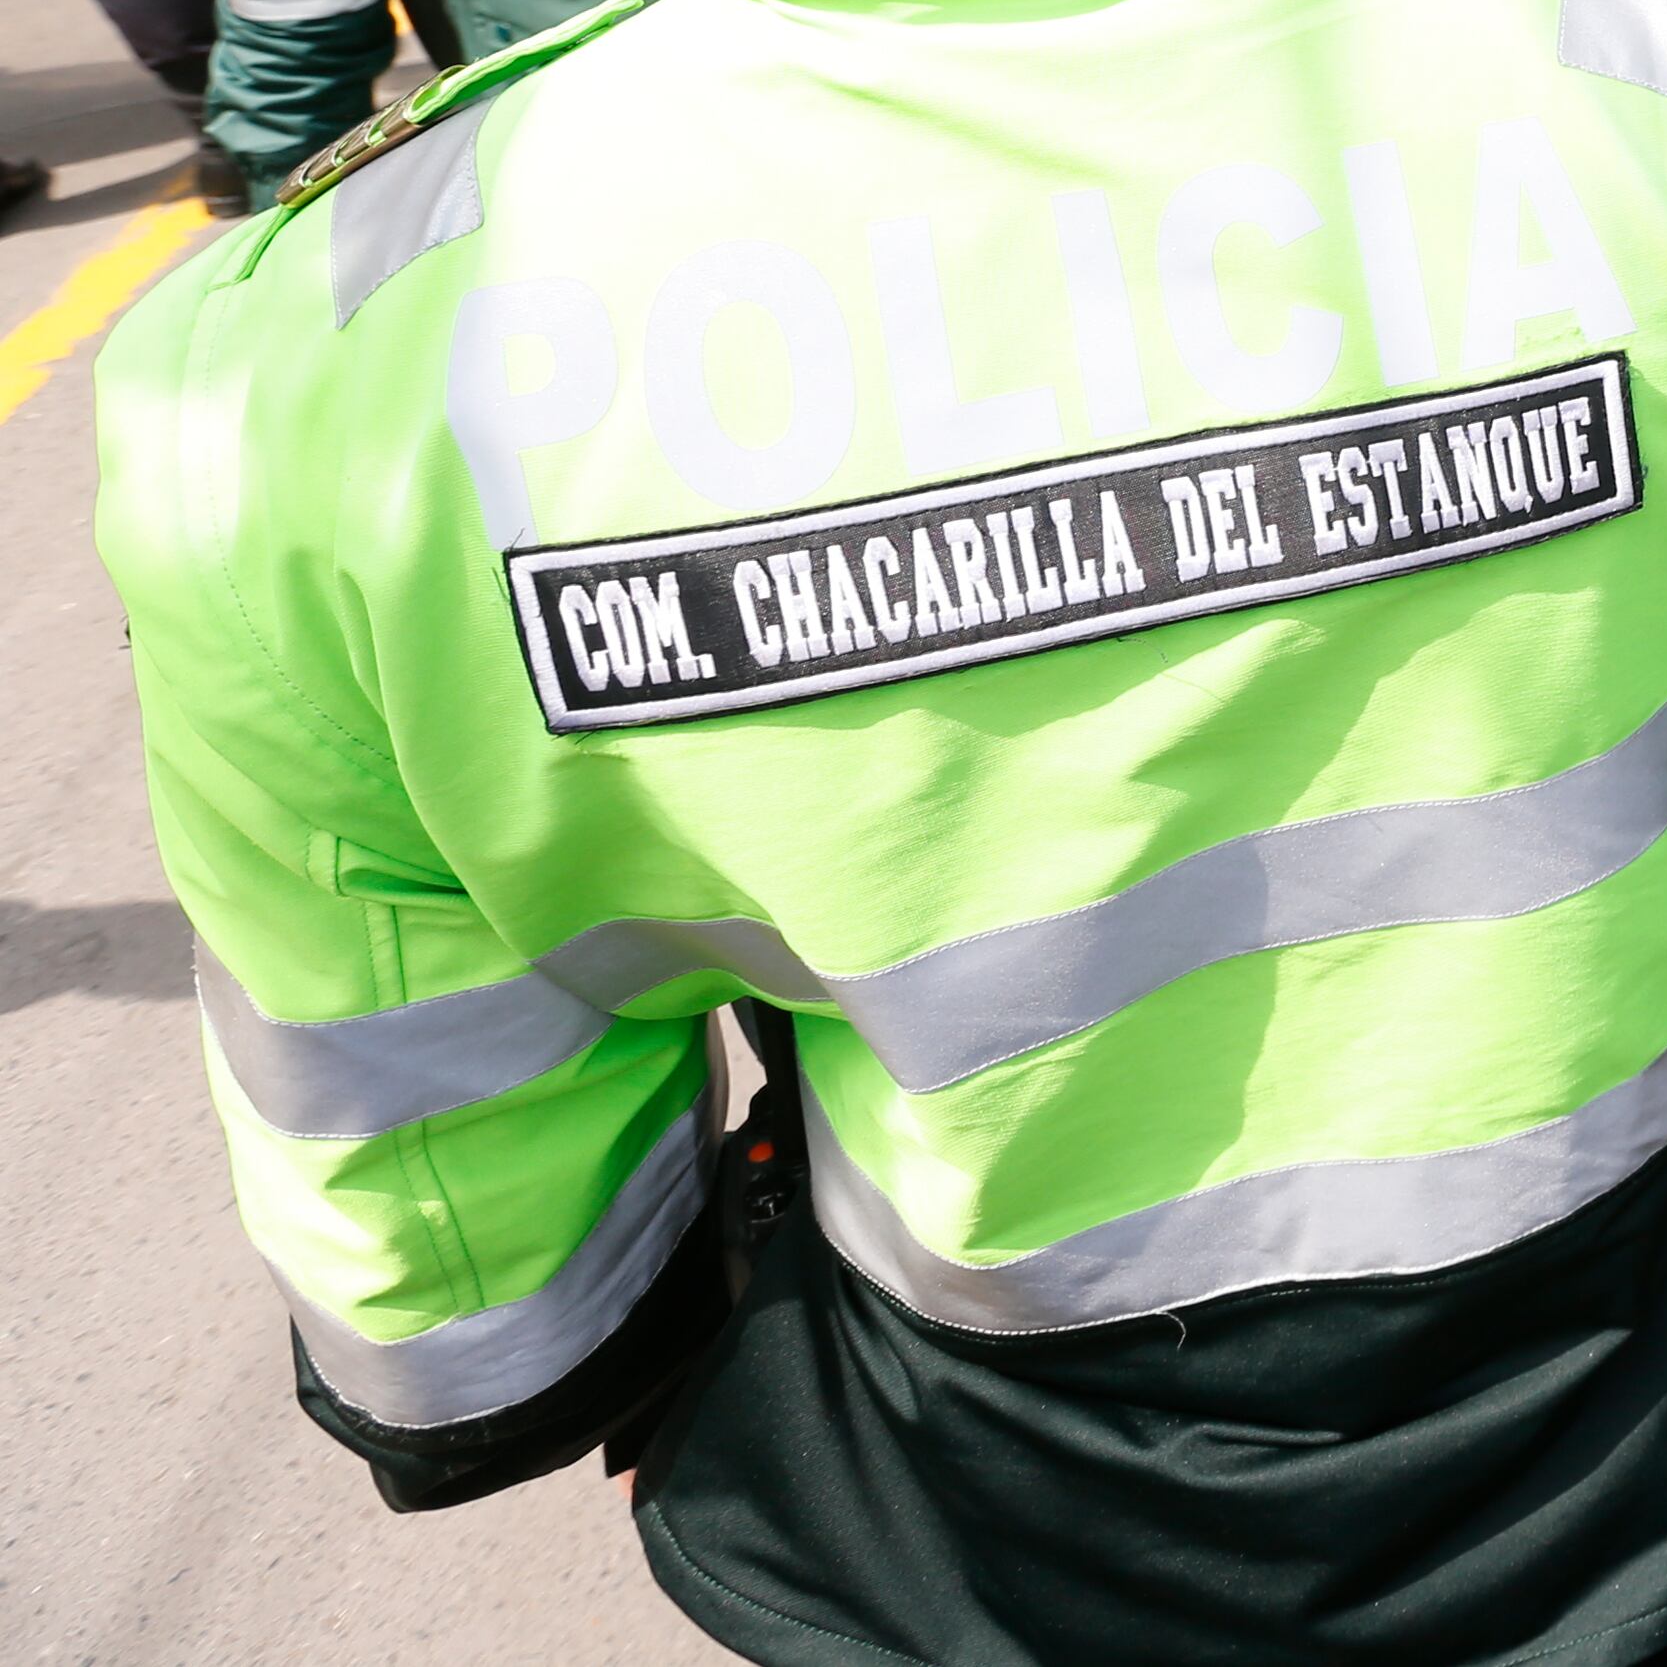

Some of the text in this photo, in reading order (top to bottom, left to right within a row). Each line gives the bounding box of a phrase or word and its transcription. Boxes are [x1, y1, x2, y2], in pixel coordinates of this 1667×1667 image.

[445, 114, 1638, 550] POLICIA
[558, 397, 1602, 693] COM. CHACARILLA DEL ESTANQUE
